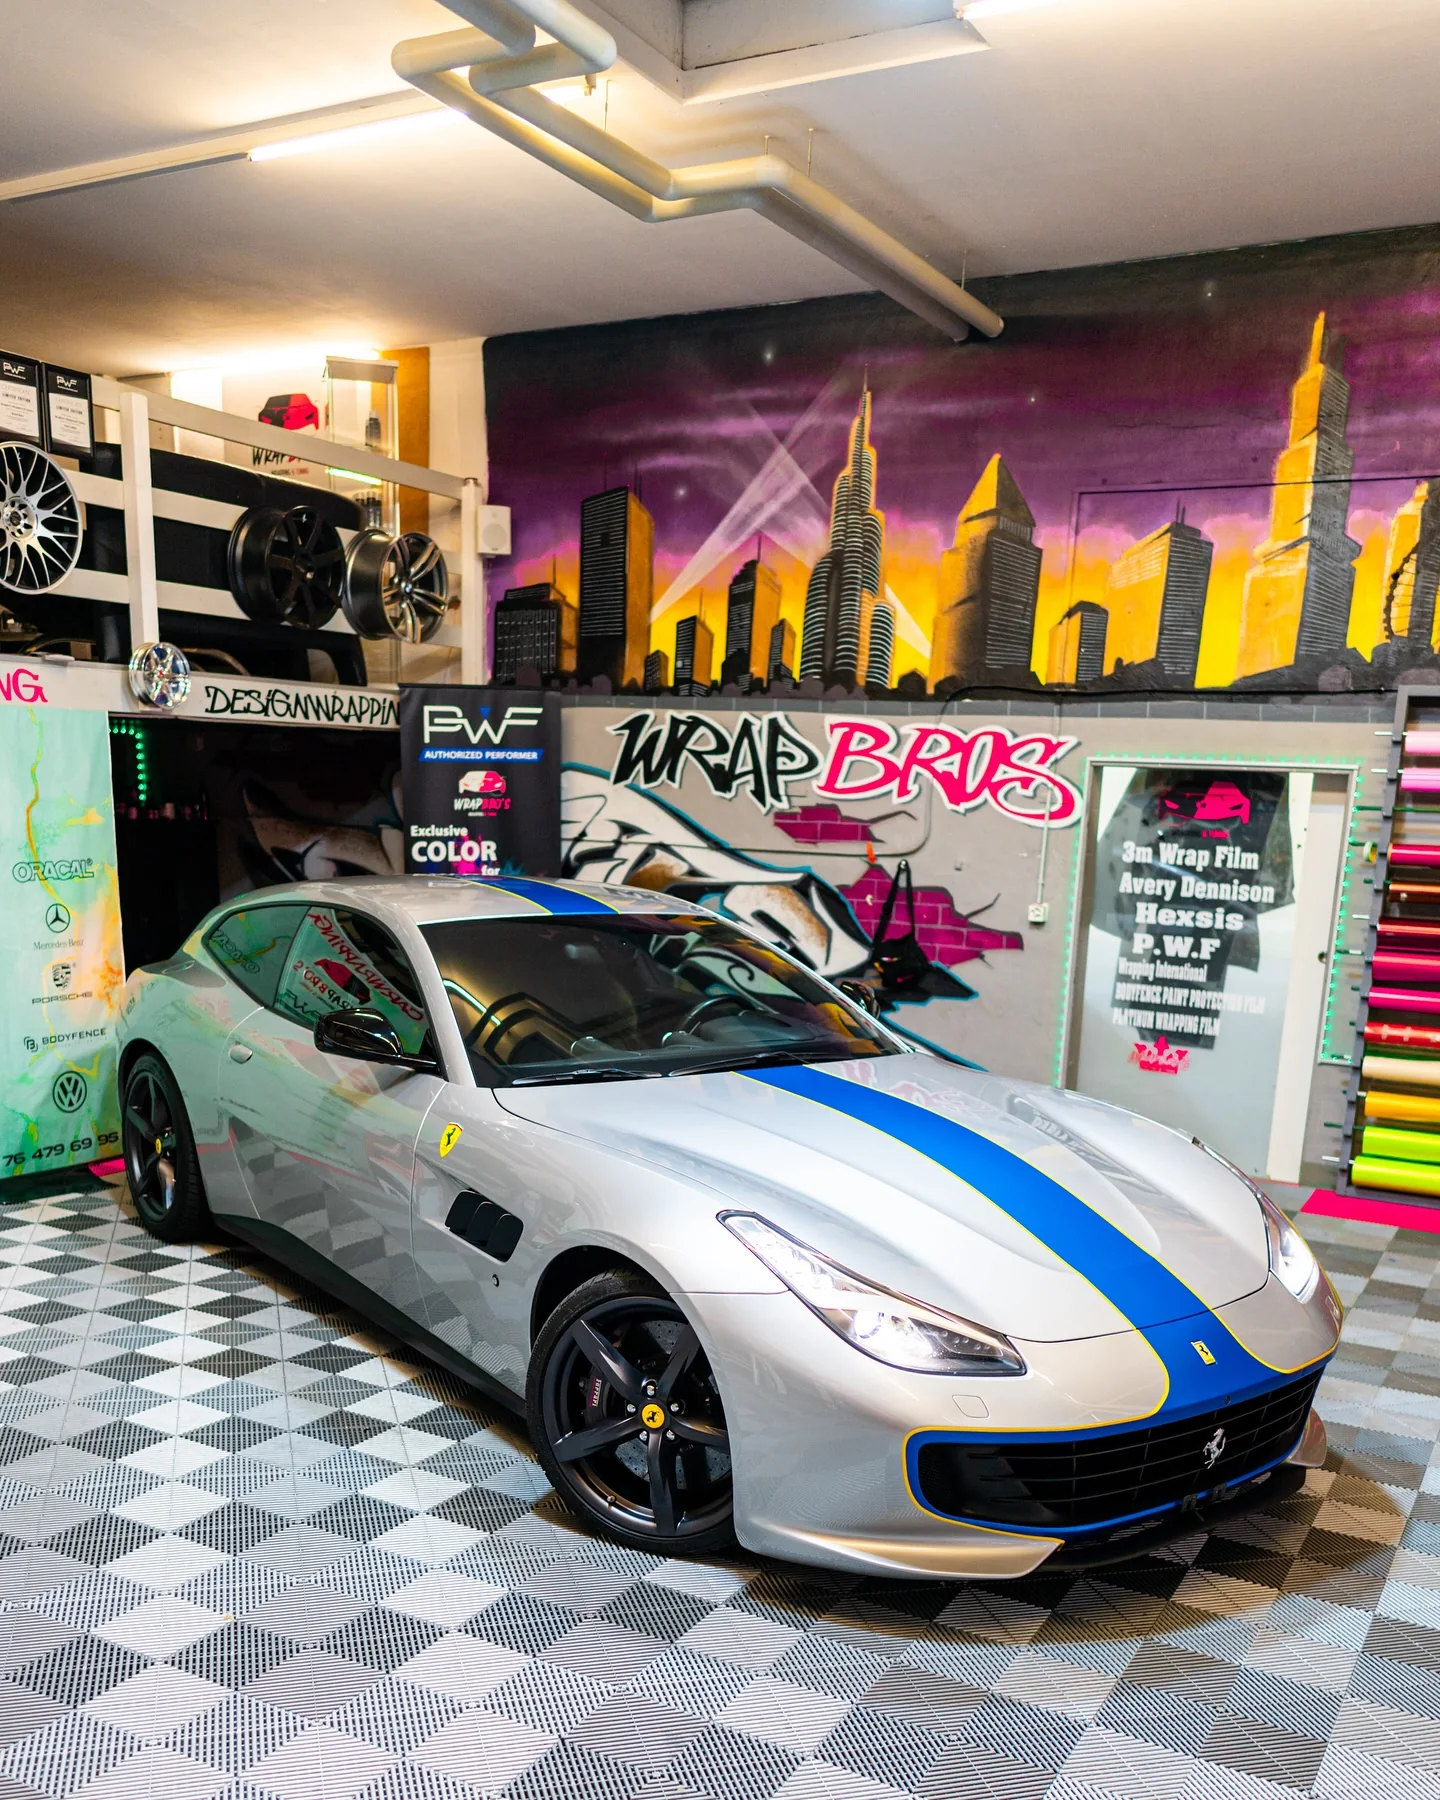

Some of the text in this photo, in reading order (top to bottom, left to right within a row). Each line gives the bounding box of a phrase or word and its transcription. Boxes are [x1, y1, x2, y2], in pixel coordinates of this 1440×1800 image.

[3, 361, 26, 374] PWF
[56, 375, 78, 387] PWF
[423, 705, 543, 744] PWF
[424, 750, 538, 760] AUTHORIZED PERFORMER
[606, 710, 1084, 828] WRAP BROS
[410, 825, 468, 837] Exclusive
[411, 840, 498, 863] COLOR
[1121, 840, 1260, 872] 3m Wrap Film
[481, 865, 501, 876] for
[1119, 872, 1275, 904] Avery Dennison
[1135, 902, 1245, 931] Hexsis
[33, 938, 84, 951] Mercedes Benz
[1132, 932, 1221, 960] P.W.F
[1118, 956, 1208, 983] Wrapping International
[32, 991, 93, 1005] PORSCHE
[1162, 986, 1190, 1007] PAINT
[1155, 1011, 1200, 1034] WRAPPING
[1198, 1016, 1221, 1036] FILM
[42, 1028, 107, 1045] BODYFENCE
[3, 1132, 119, 1167] 76 479 69 95
